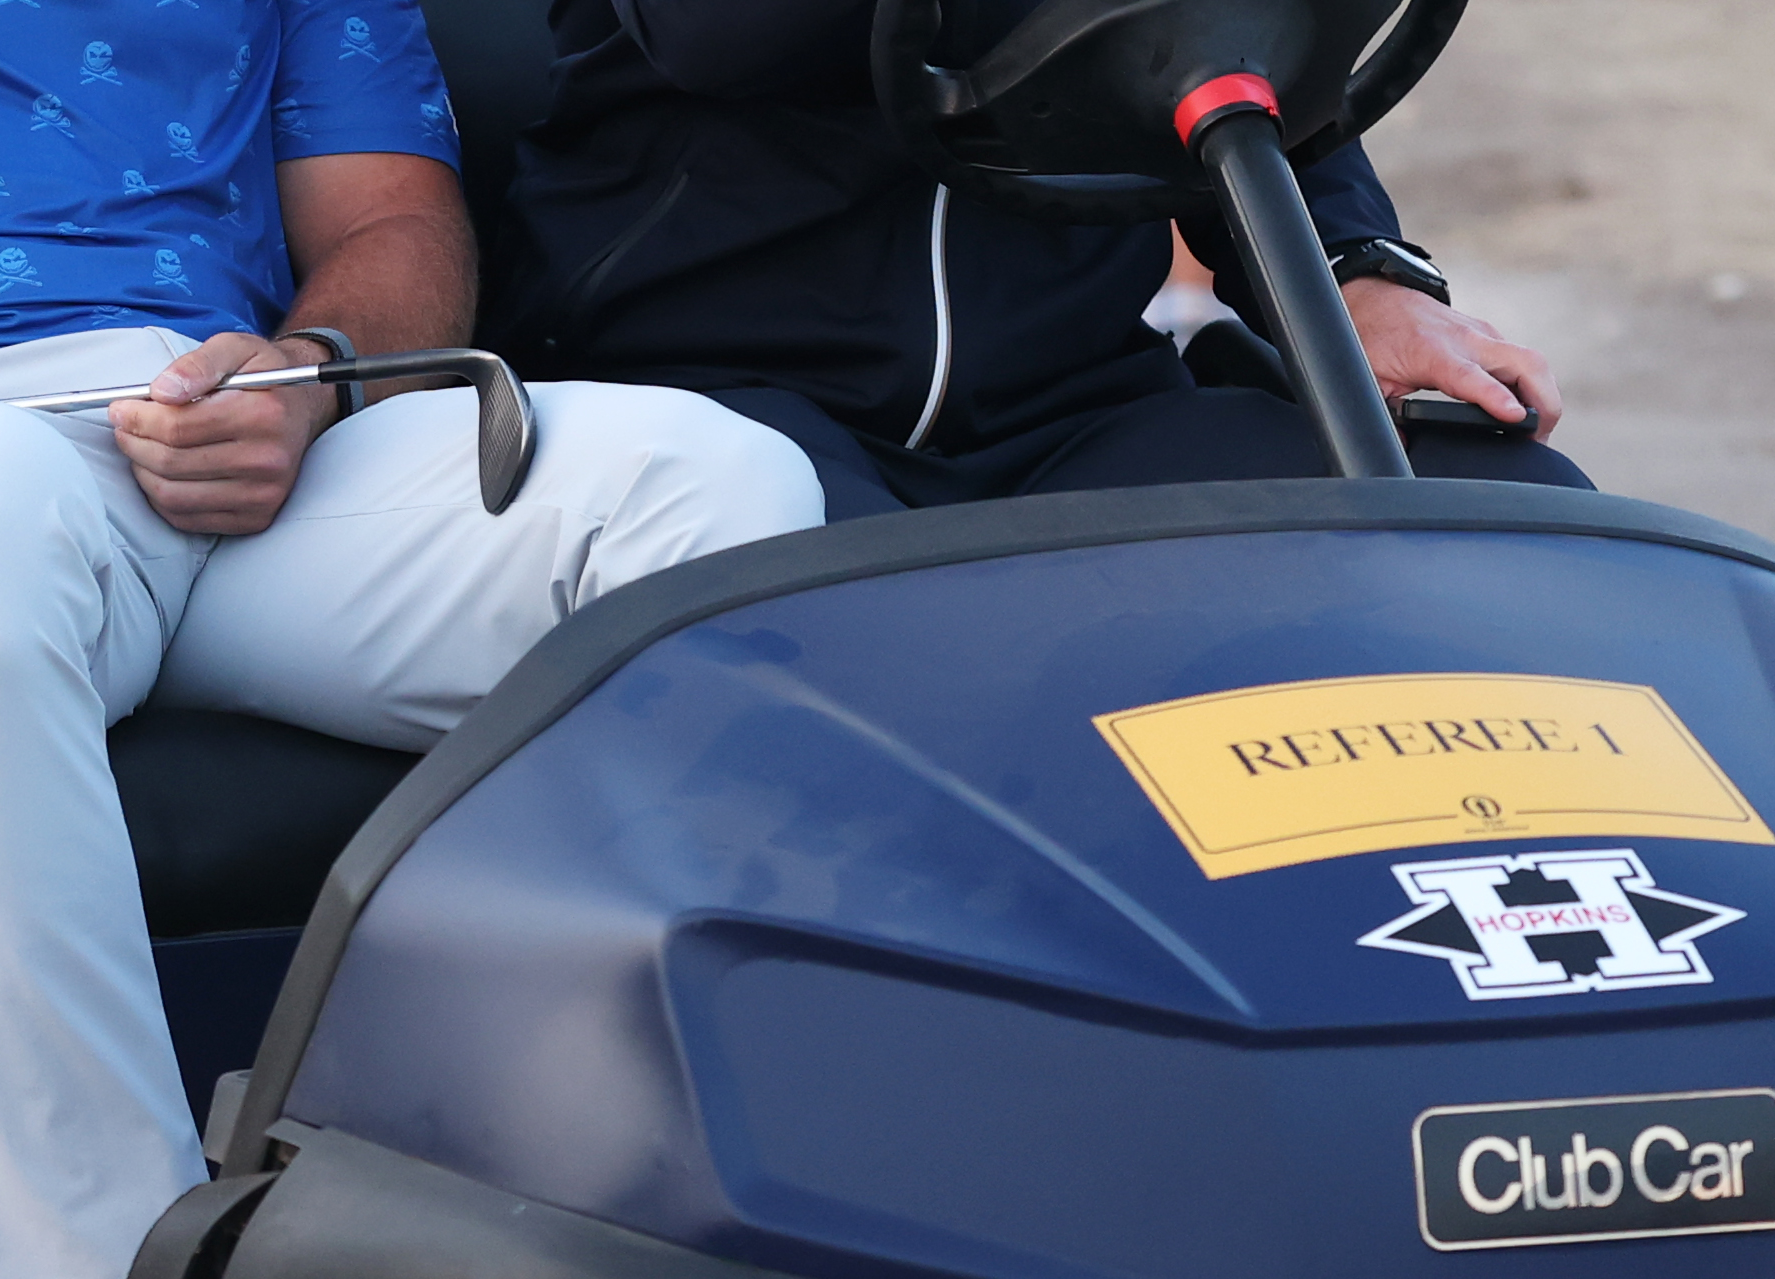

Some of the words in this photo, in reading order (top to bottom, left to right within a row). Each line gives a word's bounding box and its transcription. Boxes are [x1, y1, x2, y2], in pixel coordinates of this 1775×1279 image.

[1226, 719, 1579, 777] REFEREE
[1474, 904, 1632, 934] HOPKINS
[1457, 1131, 1624, 1215] Club
[1629, 1124, 1755, 1204] Car
